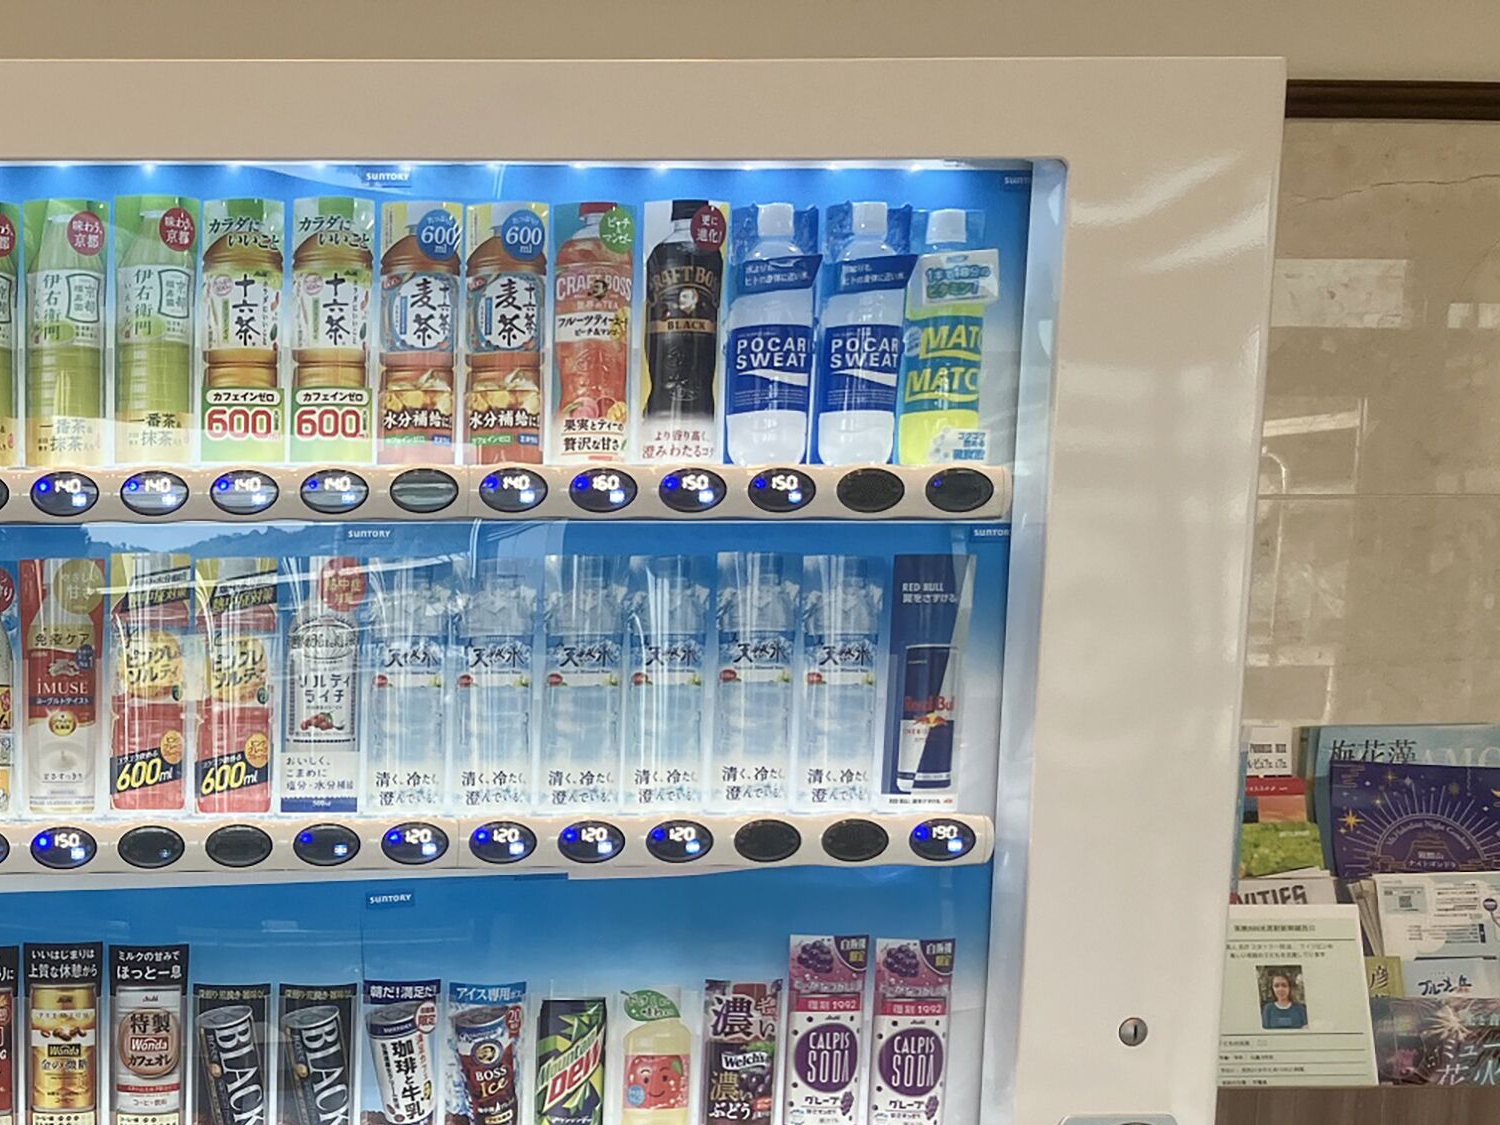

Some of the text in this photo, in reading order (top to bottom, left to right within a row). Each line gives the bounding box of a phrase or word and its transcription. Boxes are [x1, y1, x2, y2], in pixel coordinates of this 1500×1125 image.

[209, 217, 262, 233] カラダに
[299, 216, 352, 232] カラダに
[227, 232, 281, 250] いいこと
[318, 232, 370, 249] いいこと
[420, 225, 456, 246] 600
[504, 225, 543, 246] 600
[42, 273, 62, 340] 伊右衛門
[134, 268, 153, 335] 伊右衛門
[322, 272, 351, 347] 十六茶
[232, 273, 262, 347] 十六茶
[410, 278, 441, 347] 麦茶
[494, 278, 522, 348] 麦茶
[667, 320, 706, 331] BLACK
[736, 353, 806, 369] SWEAT
[830, 353, 898, 368] SWEAT
[213, 391, 276, 402] カフェインゼロ
[302, 391, 364, 402] カフェインゼロ
[207, 407, 273, 438] 600
[54, 479, 81, 493] 140
[144, 479, 171, 492] 140
[234, 478, 261, 492] 140
[681, 475, 709, 489] 150
[771, 476, 798, 490] 150
[34, 632, 90, 646] 免疫ケア
[469, 648, 526, 668] 天然水
[37, 679, 88, 694] iMUSE
[304, 690, 345, 703] ライチ
[285, 756, 332, 767] おいしく、
[285, 768, 327, 778] こまめに
[405, 829, 432, 843] 120
[492, 828, 519, 843] 120
[580, 828, 607, 842] 120
[931, 825, 958, 840] 190
[54, 834, 81, 848] 150
[31, 949, 95, 960] いいはじまりは
[118, 950, 179, 962] ミルクの甘みで
[28, 963, 98, 980] 上質な休憩から
[116, 965, 182, 981] ほっと一息
[917, 1004, 943, 1014] 1992
[129, 1013, 171, 1034] 特製
[130, 1037, 169, 1052] Wonda
[808, 1031, 851, 1051] CALPIS
[893, 1035, 936, 1054] CALPIS
[49, 1044, 81, 1057] Wonda
[127, 1053, 172, 1068] カフェオレ
[723, 1052, 768, 1069] Welch's
[806, 1050, 850, 1084] SODA
[389, 1038, 426, 1120] 珈琲と牛乳
[475, 1066, 508, 1082] BOSS
[891, 1054, 934, 1088] SODA
[480, 1077, 510, 1098] Ice
[710, 1070, 754, 1102] 濃い
[803, 1096, 840, 1107] グレープ
[888, 1100, 925, 1111] グレープ
[708, 1102, 752, 1120] ぶどう
